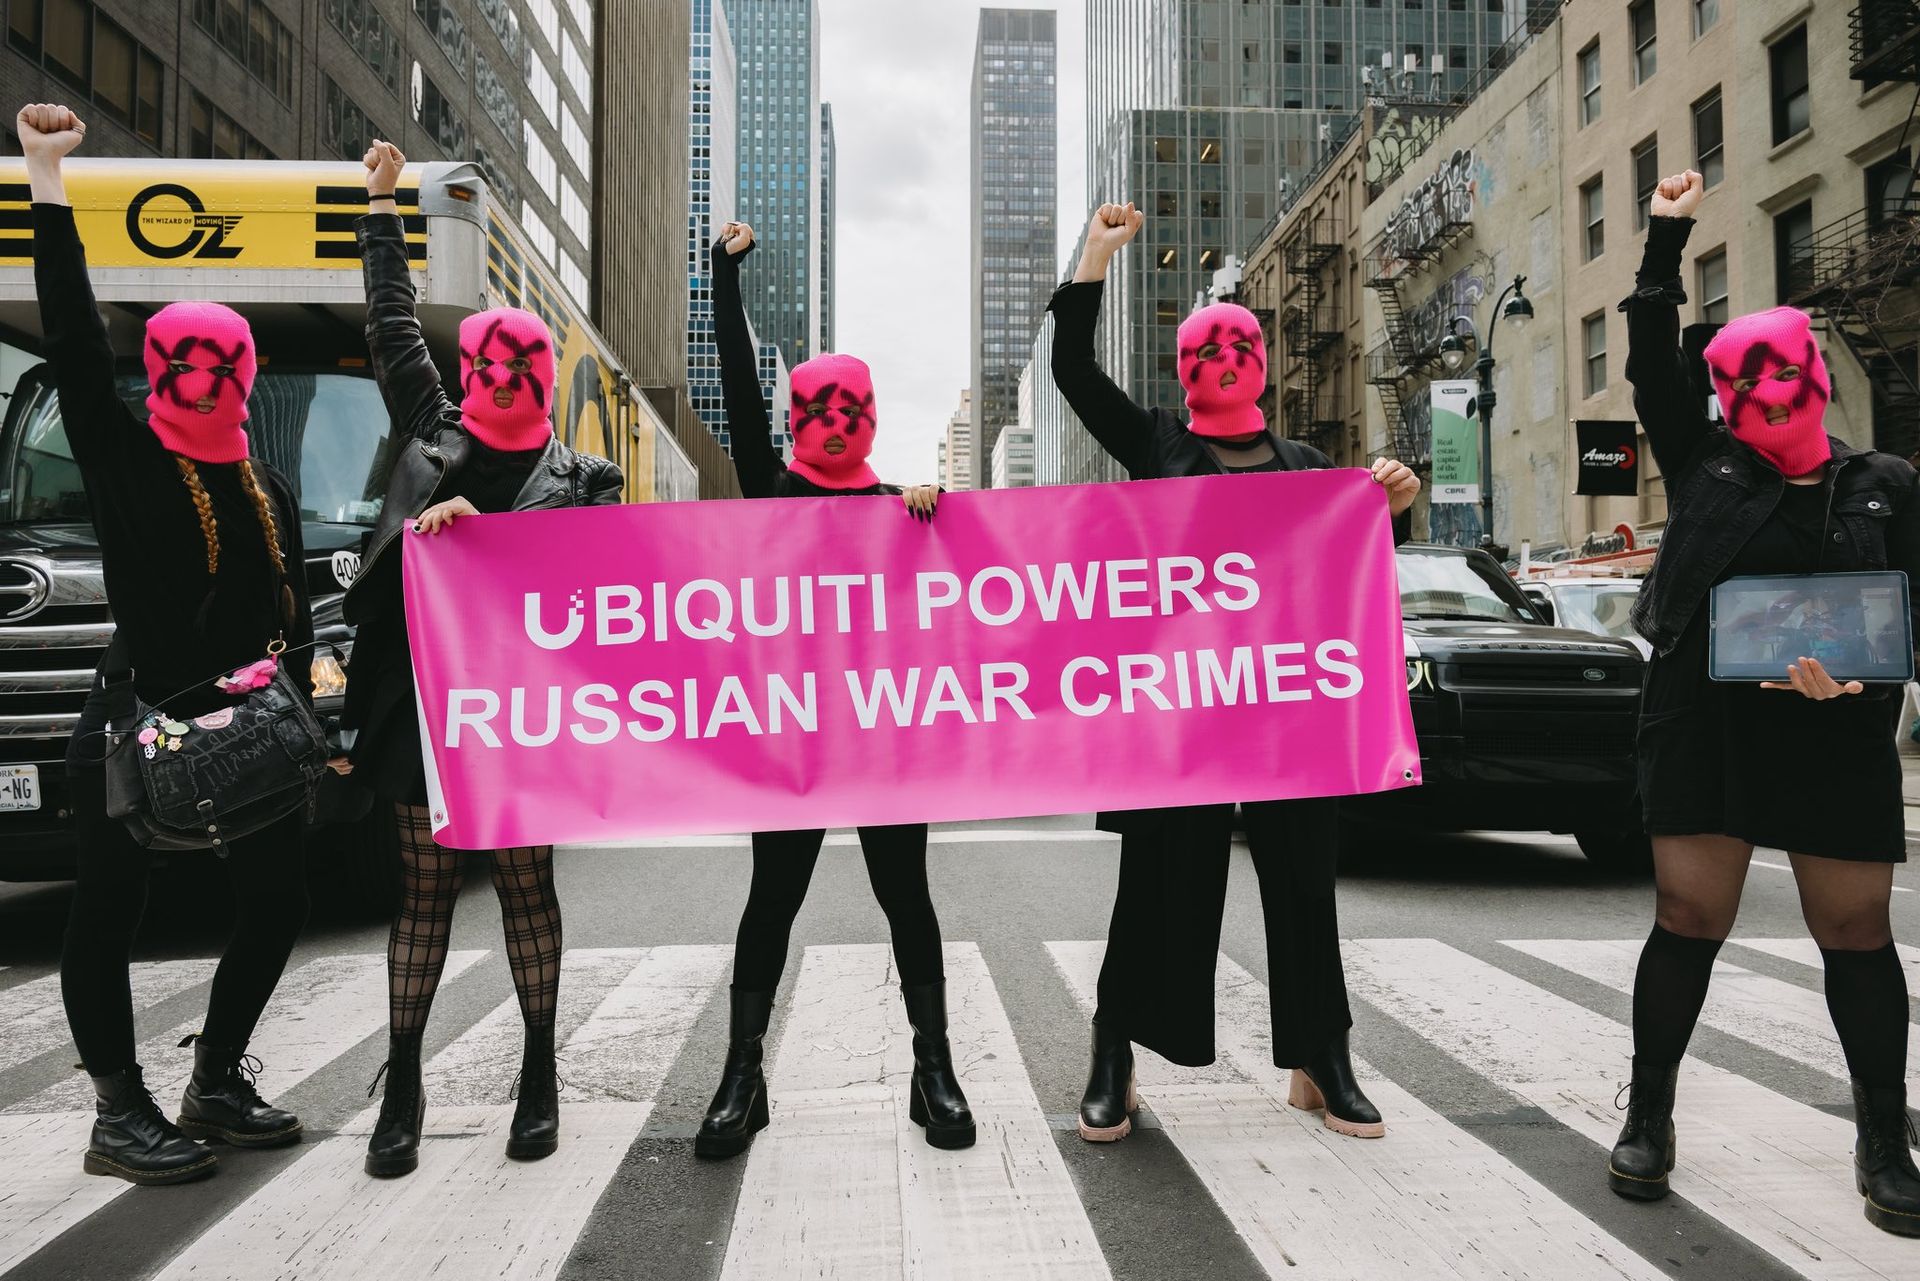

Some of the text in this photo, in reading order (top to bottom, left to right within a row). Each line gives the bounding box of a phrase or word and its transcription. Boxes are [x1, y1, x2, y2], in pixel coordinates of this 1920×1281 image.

[195, 217, 222, 225] MOVING
[1437, 438, 1453, 446] Real
[1582, 448, 1626, 465] Amaze
[524, 552, 1260, 650] UBIQUITI POWERS
[445, 639, 1364, 748] RUSSIAN WAR CRIMES
